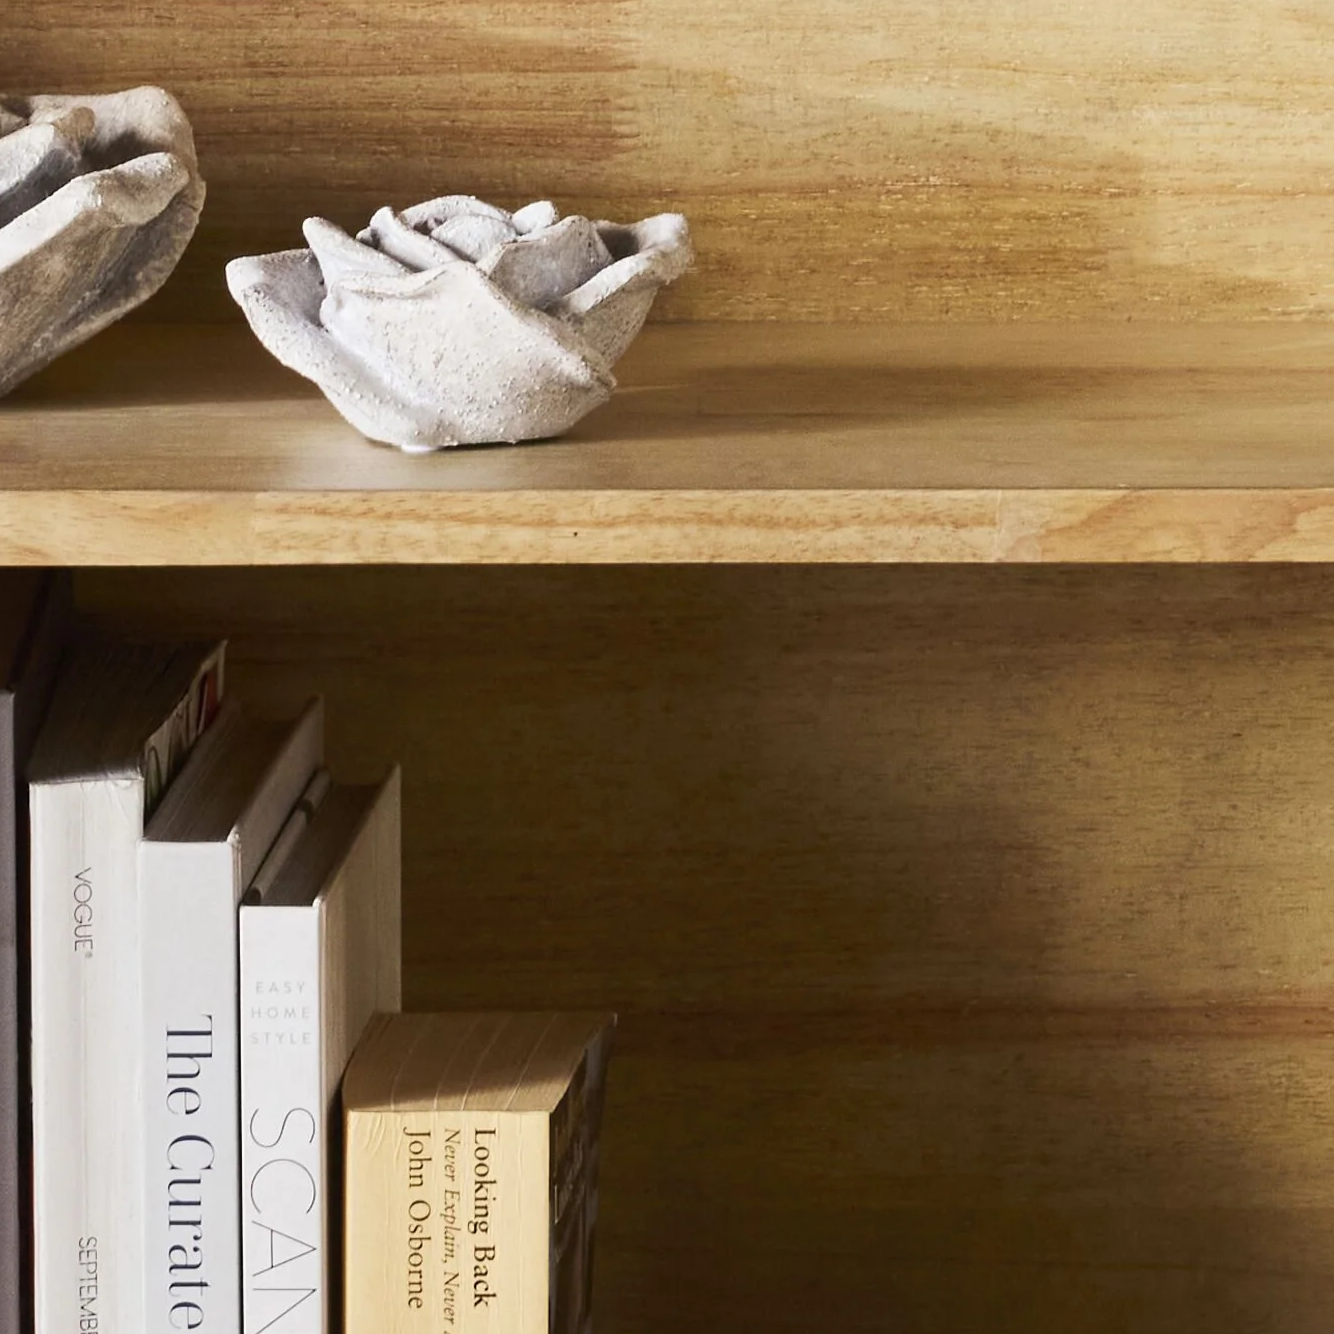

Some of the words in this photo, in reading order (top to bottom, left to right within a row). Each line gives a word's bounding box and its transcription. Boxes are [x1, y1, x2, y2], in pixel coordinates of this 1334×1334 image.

[250, 1006, 311, 1020] HOME
[255, 981, 307, 995] EASY
[166, 1014, 214, 1116] The
[250, 1031, 312, 1045] STYLE
[403, 1126, 433, 1189] John
[443, 1128, 461, 1181] Never
[467, 1128, 497, 1235] Looking
[407, 1199, 433, 1310] Osborne
[440, 1189, 462, 1264] Explain,
[443, 1271, 461, 1325] Never
[473, 1245, 498, 1308] Back
